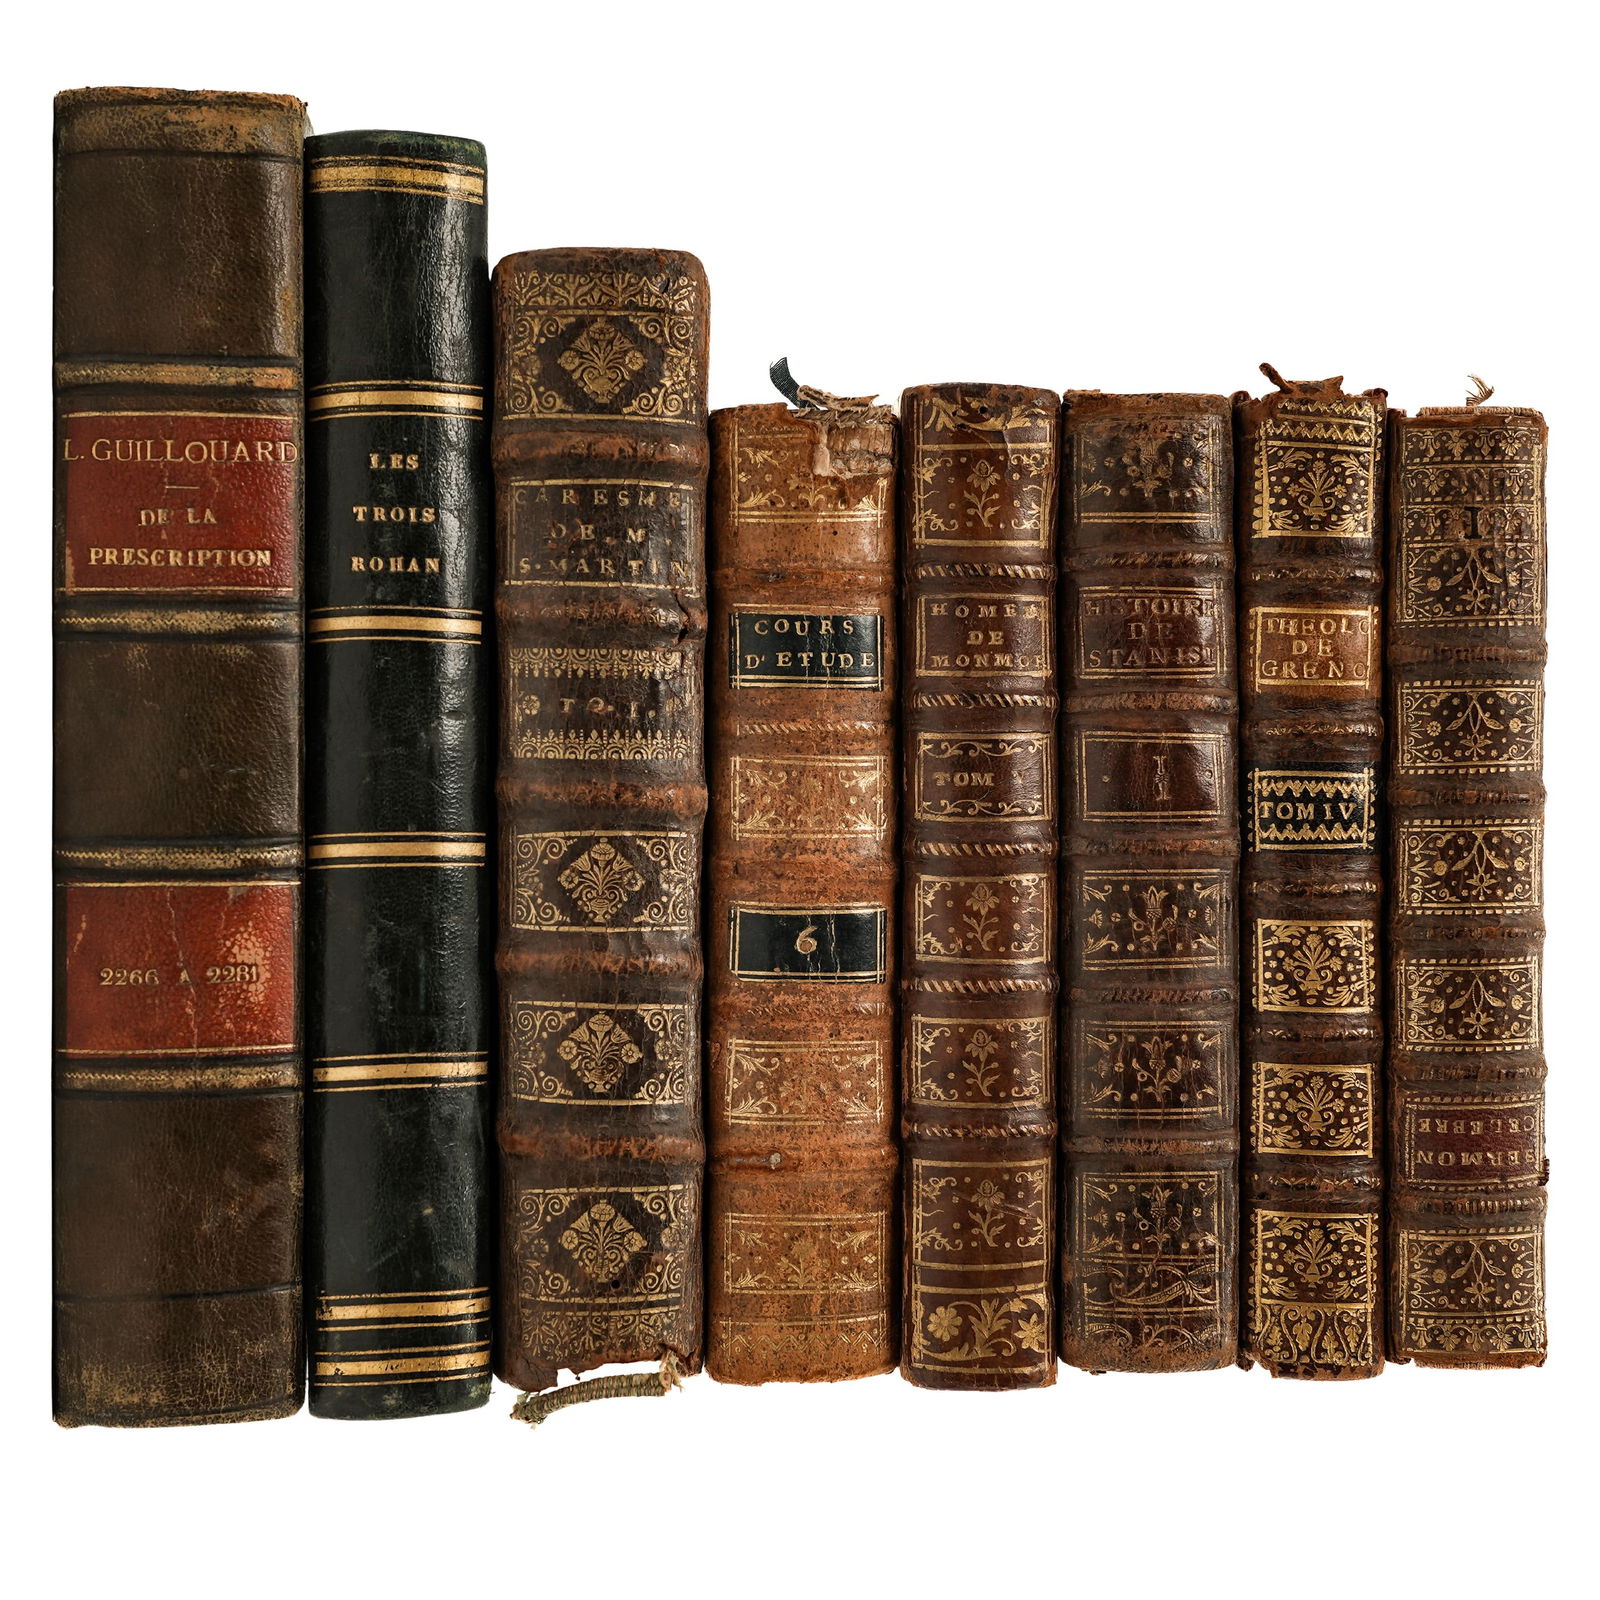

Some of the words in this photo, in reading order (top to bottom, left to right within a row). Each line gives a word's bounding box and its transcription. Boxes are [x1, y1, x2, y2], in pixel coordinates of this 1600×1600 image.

[63, 438, 85, 461] L.
[92, 438, 298, 464] GUILLOUARD
[369, 453, 419, 470] LES
[139, 507, 169, 526] DE
[187, 508, 217, 524] LA
[353, 506, 436, 523] TROIS
[88, 548, 272, 568] PRESCRIPTION
[351, 556, 440, 573] ROHAN
[754, 618, 855, 636] COURS
[1127, 622, 1174, 640] DE
[966, 630, 1005, 646] DE
[1292, 639, 1334, 656] DE
[1261, 659, 1367, 678] GRENO
[933, 771, 995, 787] TOM
[1260, 801, 1315, 820] TOM
[1322, 802, 1358, 820] IV
[794, 925, 819, 955] 6
[100, 967, 160, 985] 2266
[206, 965, 259, 984] 2281
[1418, 1115, 1536, 1135] CELEBRE
[1415, 1149, 1536, 1166] SERMON
